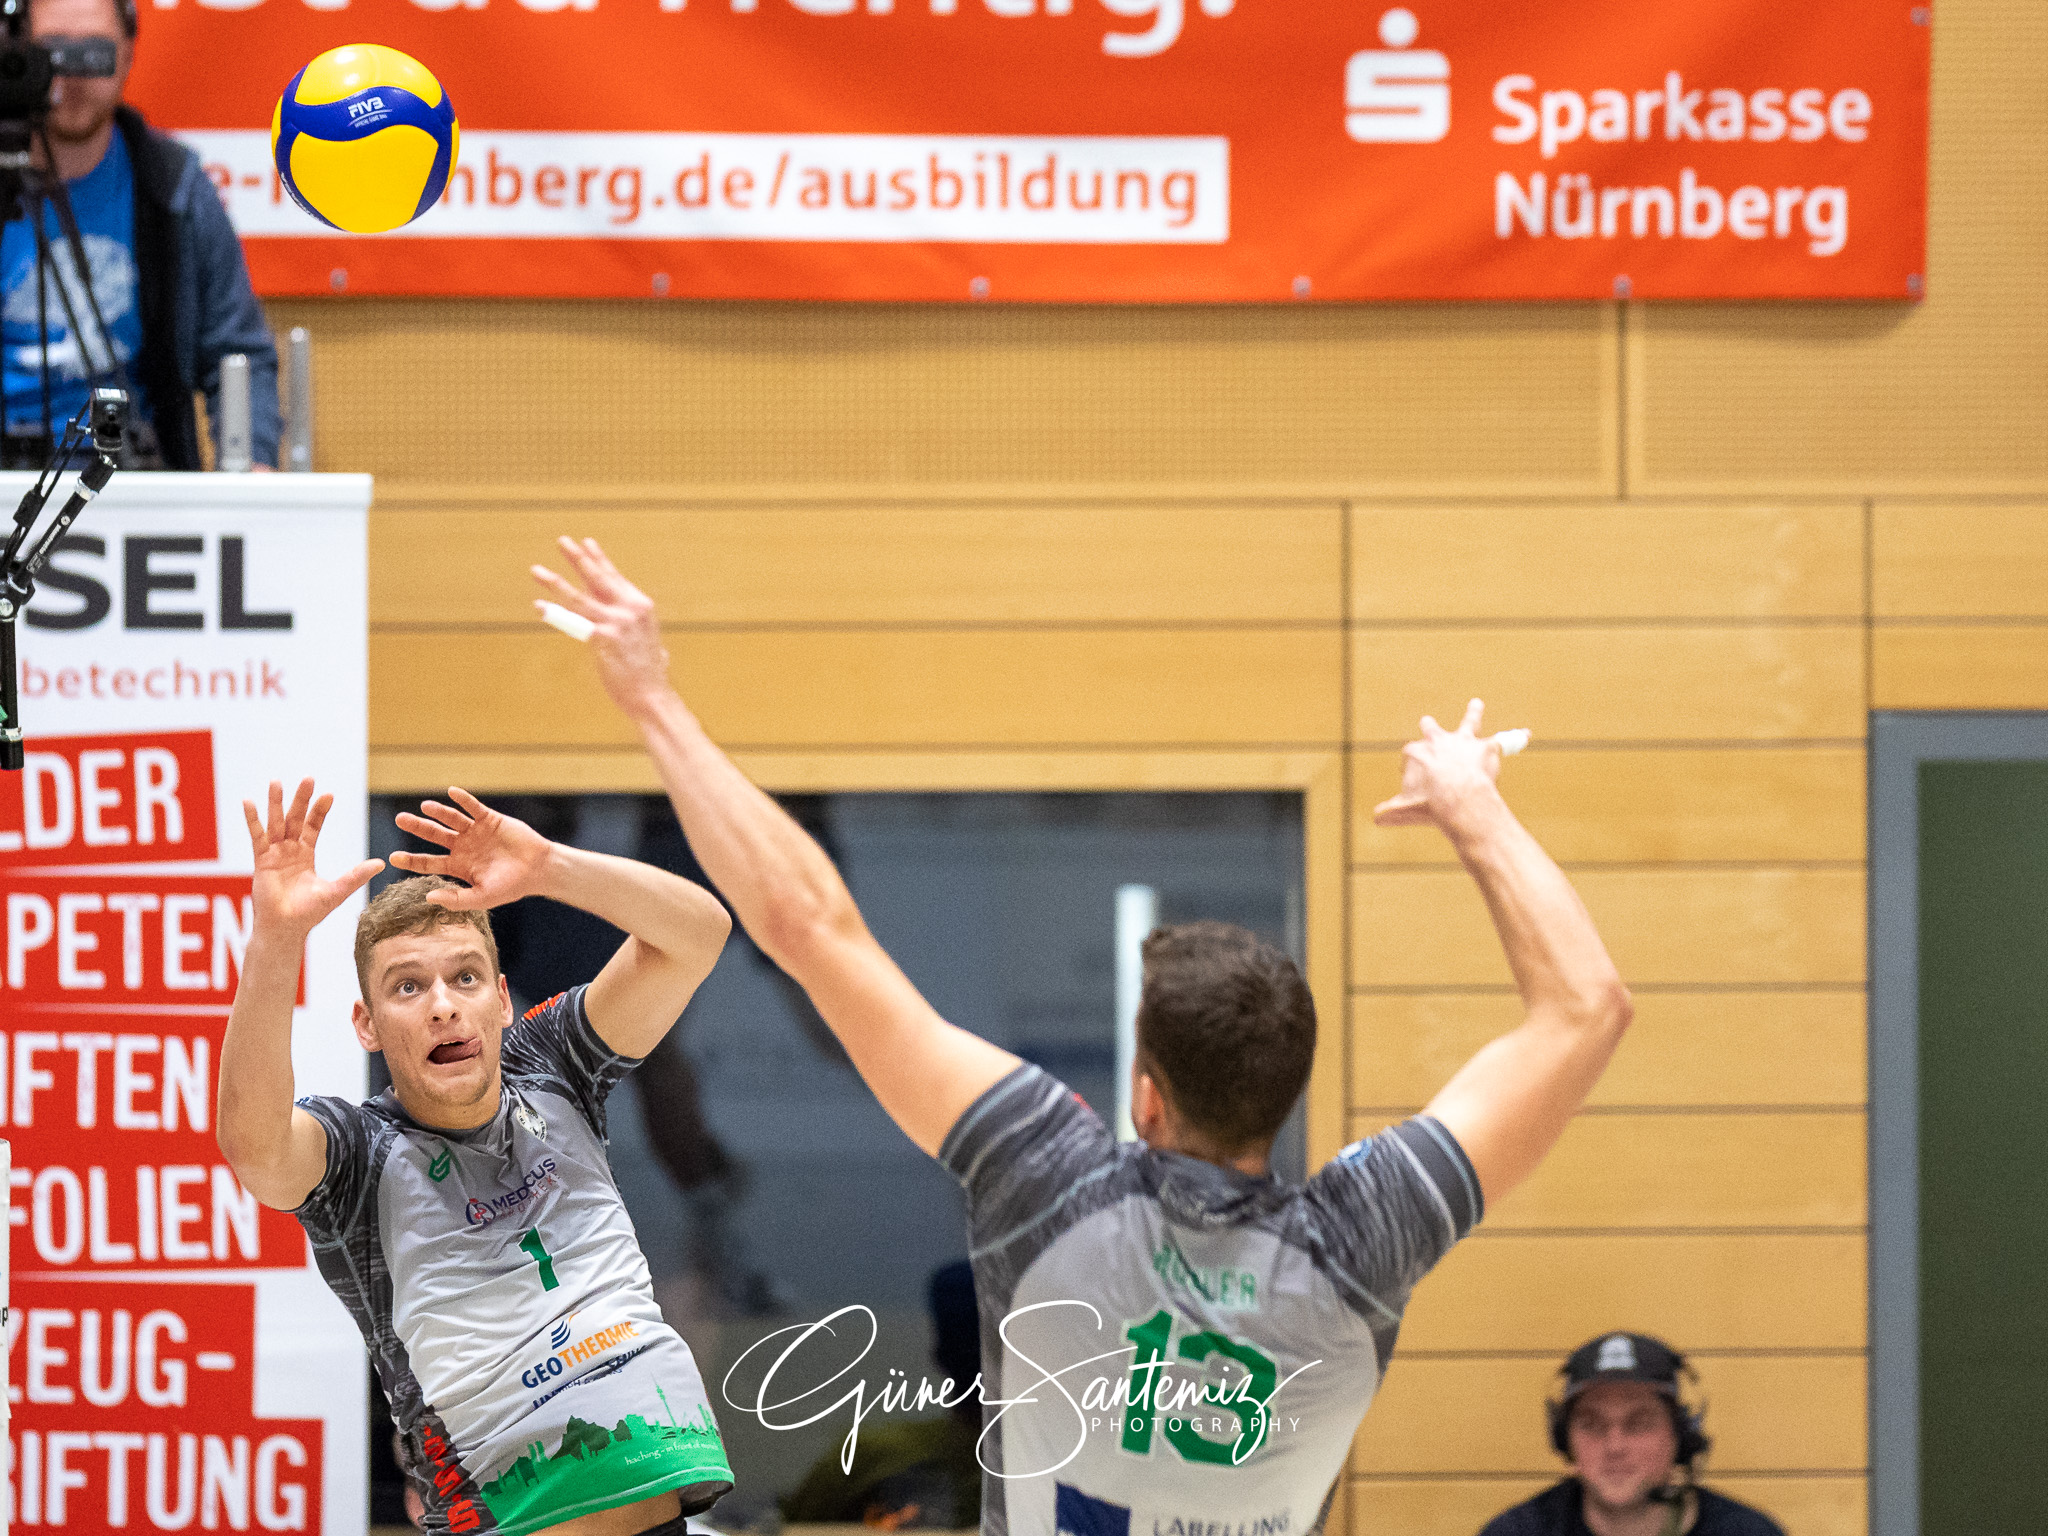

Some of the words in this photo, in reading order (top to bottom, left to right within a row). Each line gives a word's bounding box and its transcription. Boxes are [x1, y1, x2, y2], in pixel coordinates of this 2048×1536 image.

[1493, 72, 1872, 157] Sparkasse
[1494, 169, 1848, 256] Nürnberg
[0, 534, 294, 631] SEL
[0, 893, 254, 990] PETEN
[518, 1224, 560, 1293] 1
[521, 1321, 640, 1388] GEOTHERMIE
[1120, 1308, 1281, 1468] 13
[9, 1430, 308, 1532] IFTUNG
